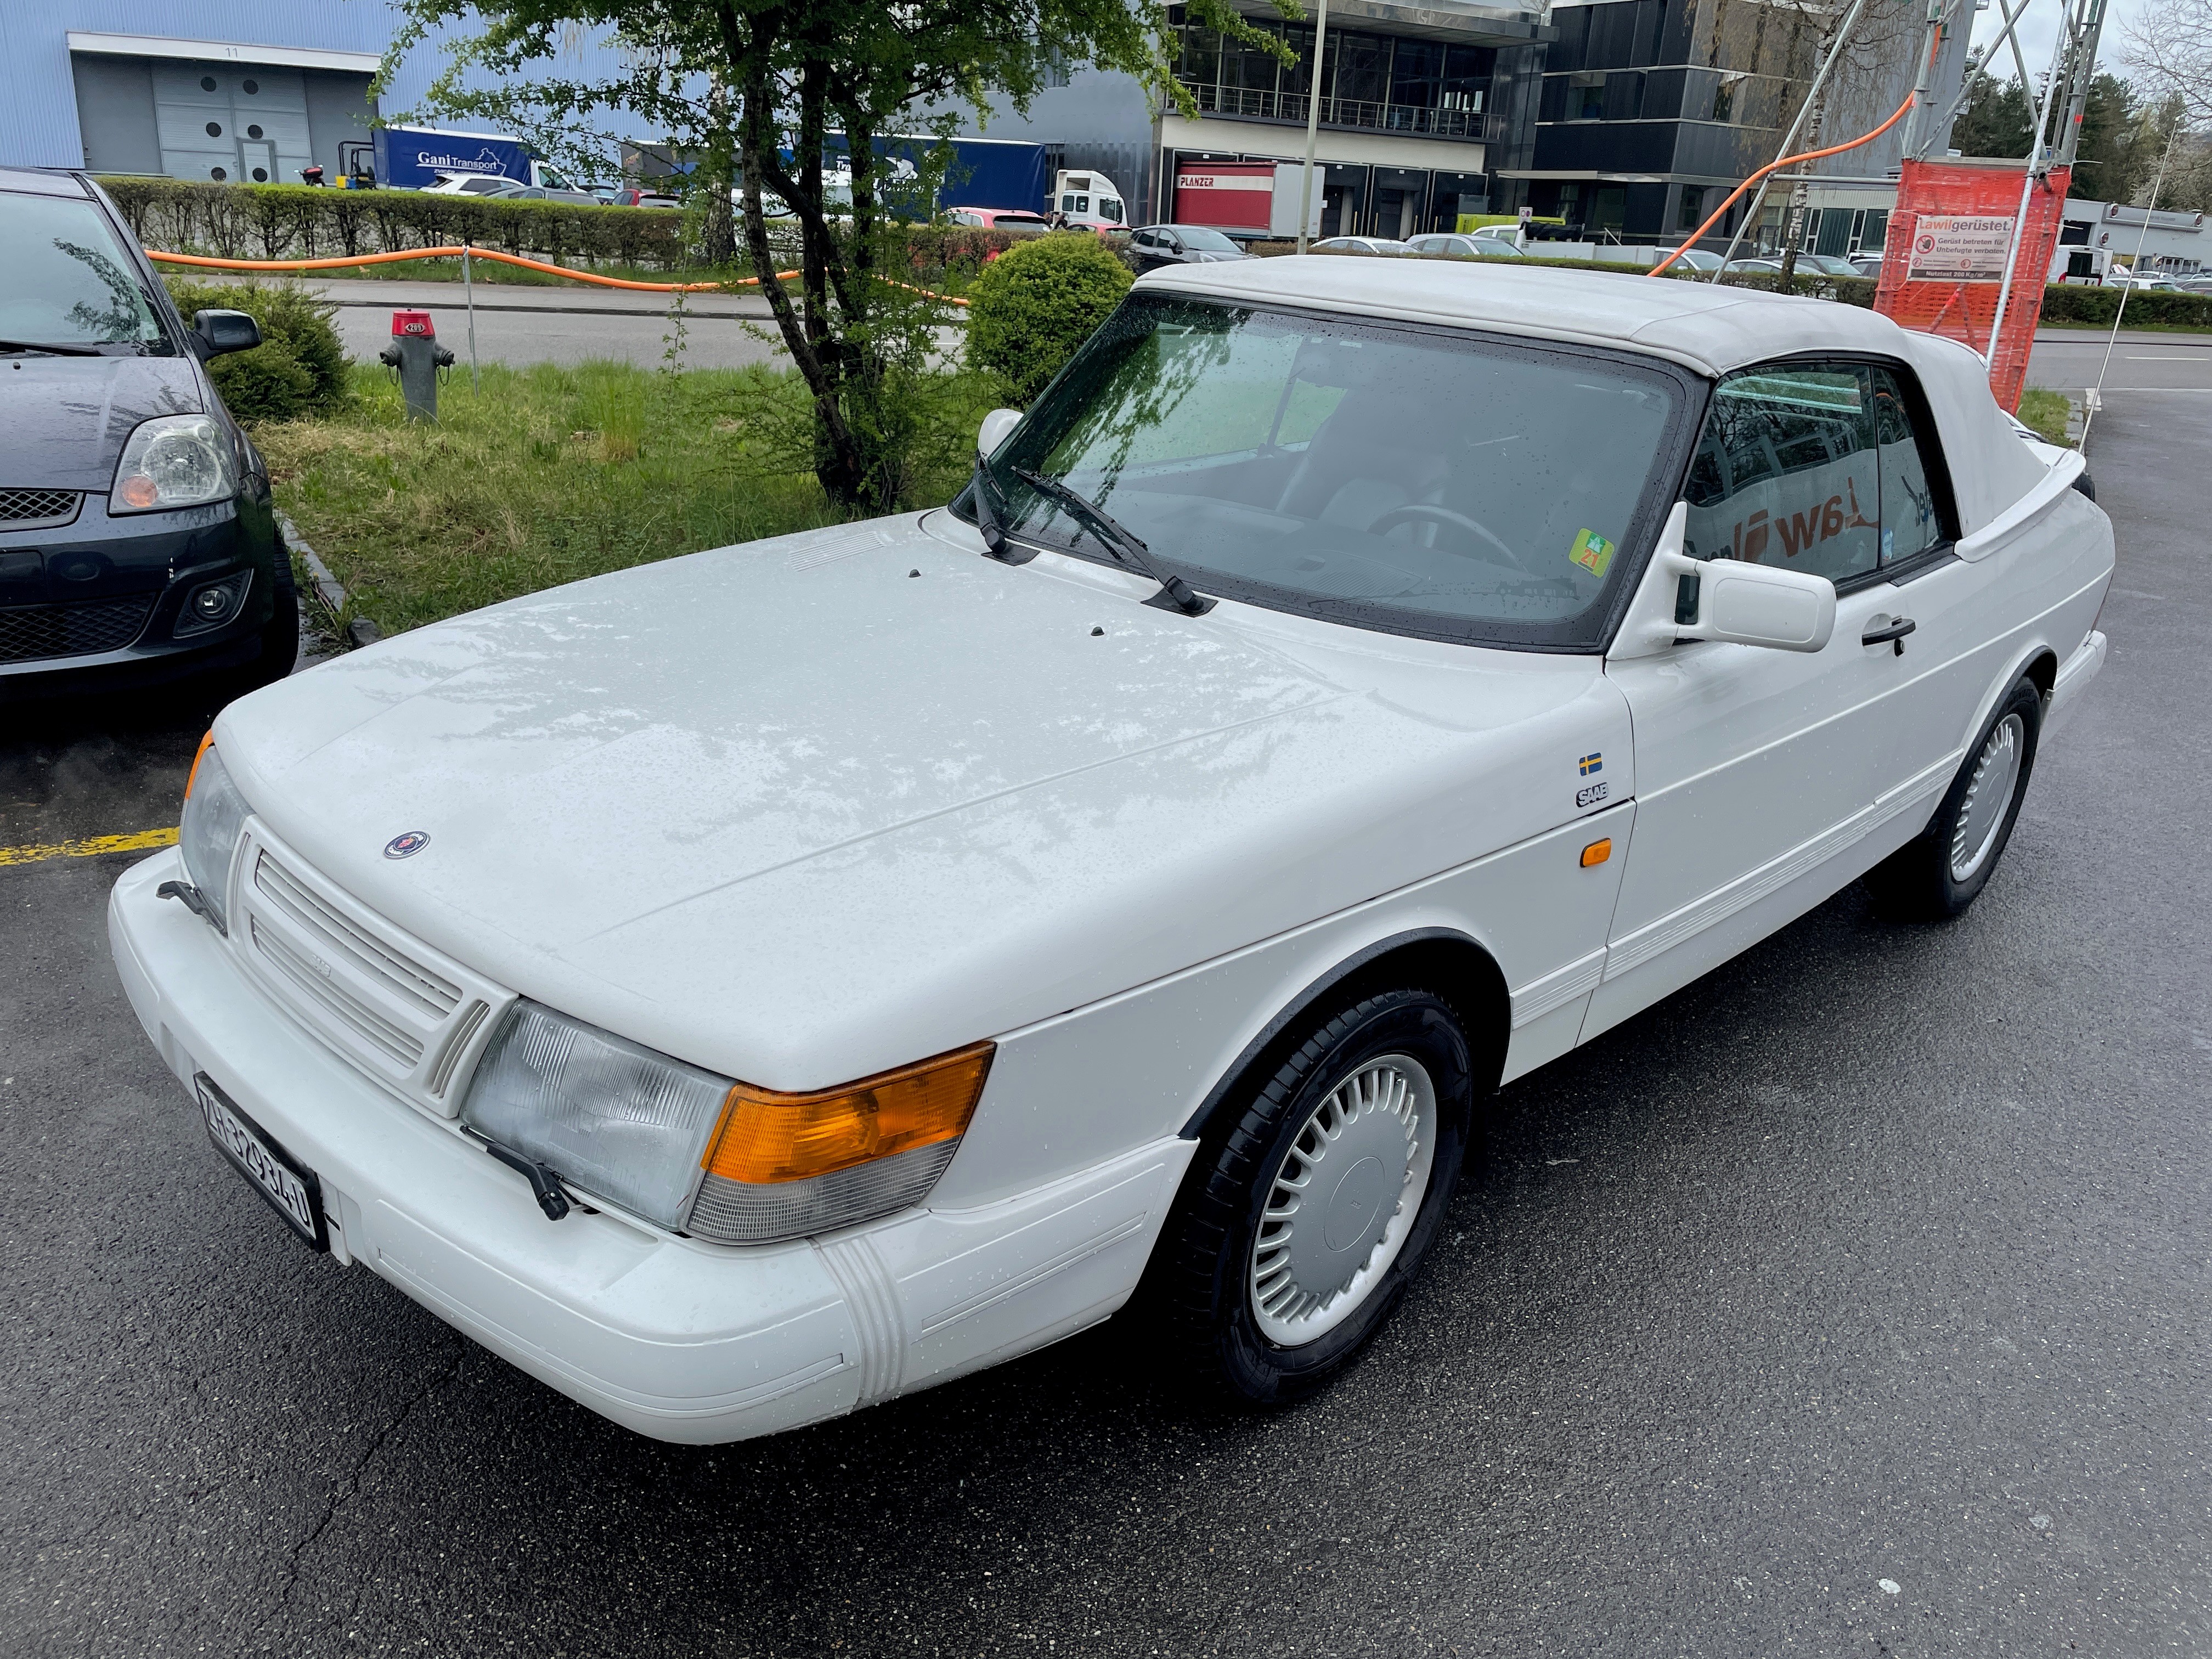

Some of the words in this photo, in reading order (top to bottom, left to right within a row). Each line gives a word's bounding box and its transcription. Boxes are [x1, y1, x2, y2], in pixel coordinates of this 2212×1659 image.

[225, 47, 238, 58] 11
[417, 151, 450, 166] Gani
[451, 157, 497, 170] Transport
[1181, 177, 1214, 187] PLANZER
[1581, 549, 1599, 568] 21
[1576, 782, 1609, 807] SAAB
